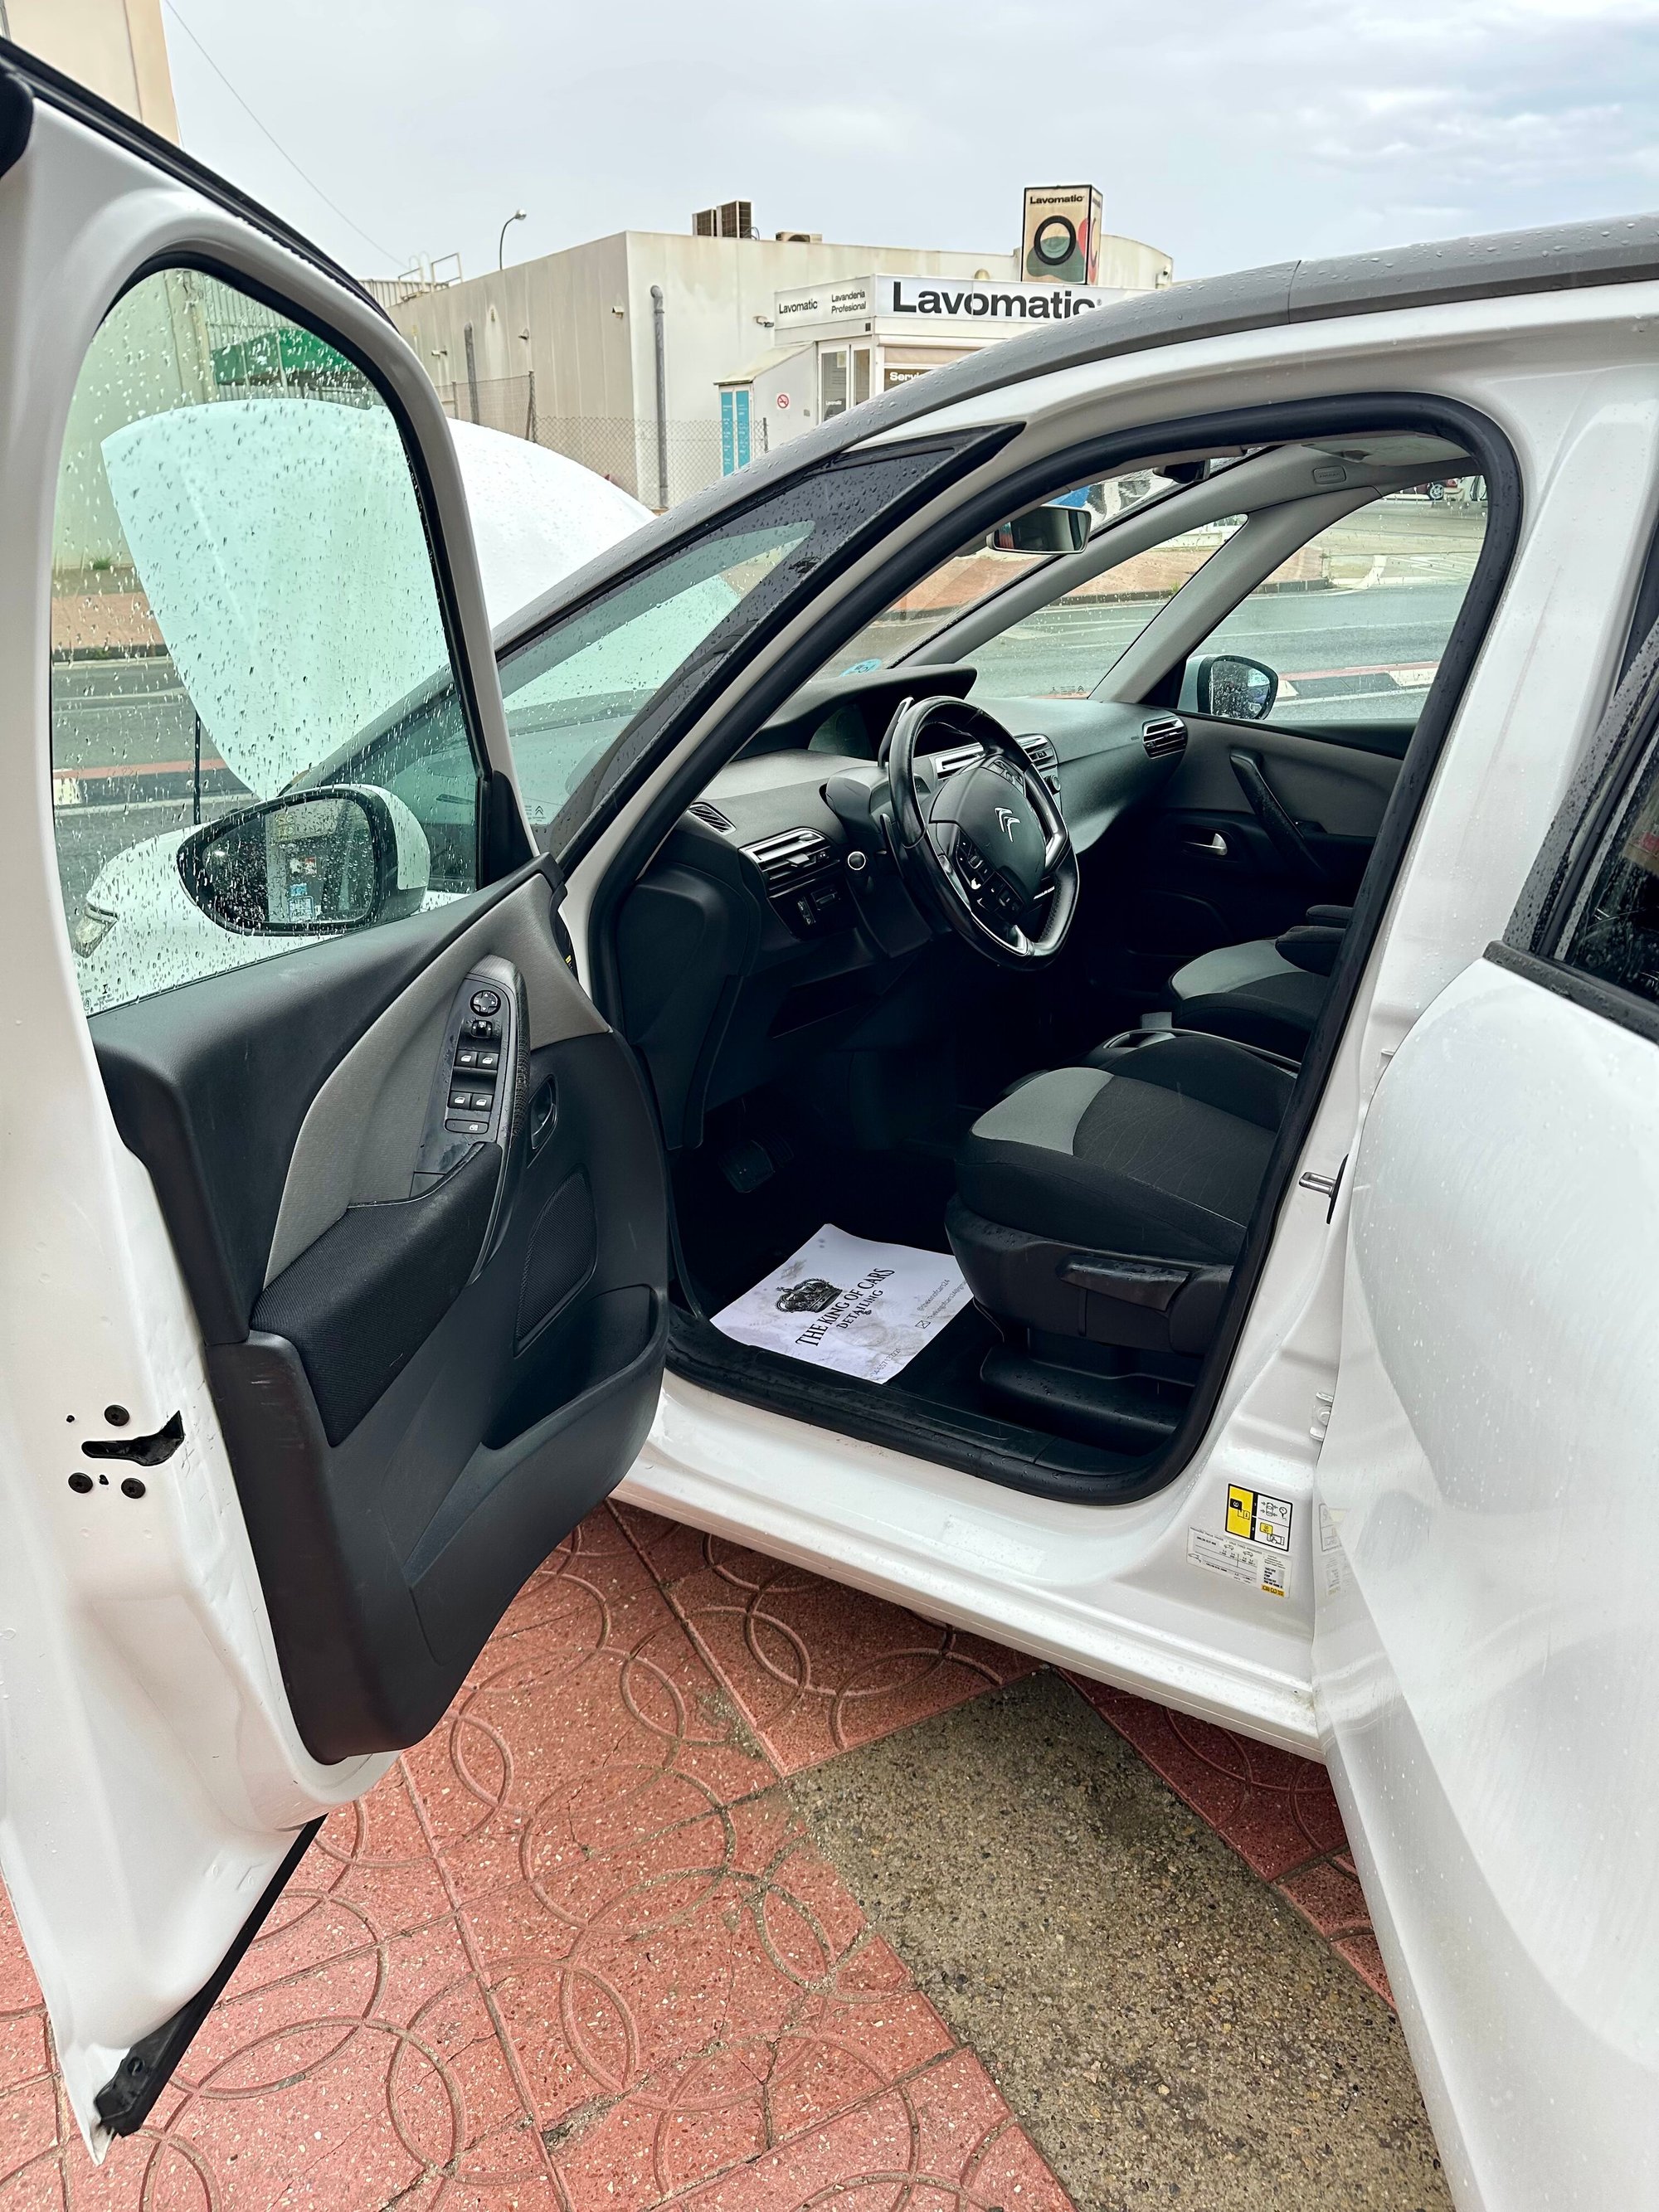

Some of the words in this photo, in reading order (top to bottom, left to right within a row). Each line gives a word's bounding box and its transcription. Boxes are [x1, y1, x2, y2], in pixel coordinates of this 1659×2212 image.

[1029, 195, 1083, 204] Lavomatic
[831, 289, 865, 303] Lavanderia
[893, 281, 1096, 318] Lavomatic
[779, 299, 818, 314] Lavomatic
[831, 301, 867, 314] Profesional
[795, 1324, 829, 1346] THE
[817, 1301, 849, 1325] KING
[844, 1289, 864, 1300] OF
[857, 1268, 895, 1290] CARS
[836, 1290, 883, 1329] DETAILING
